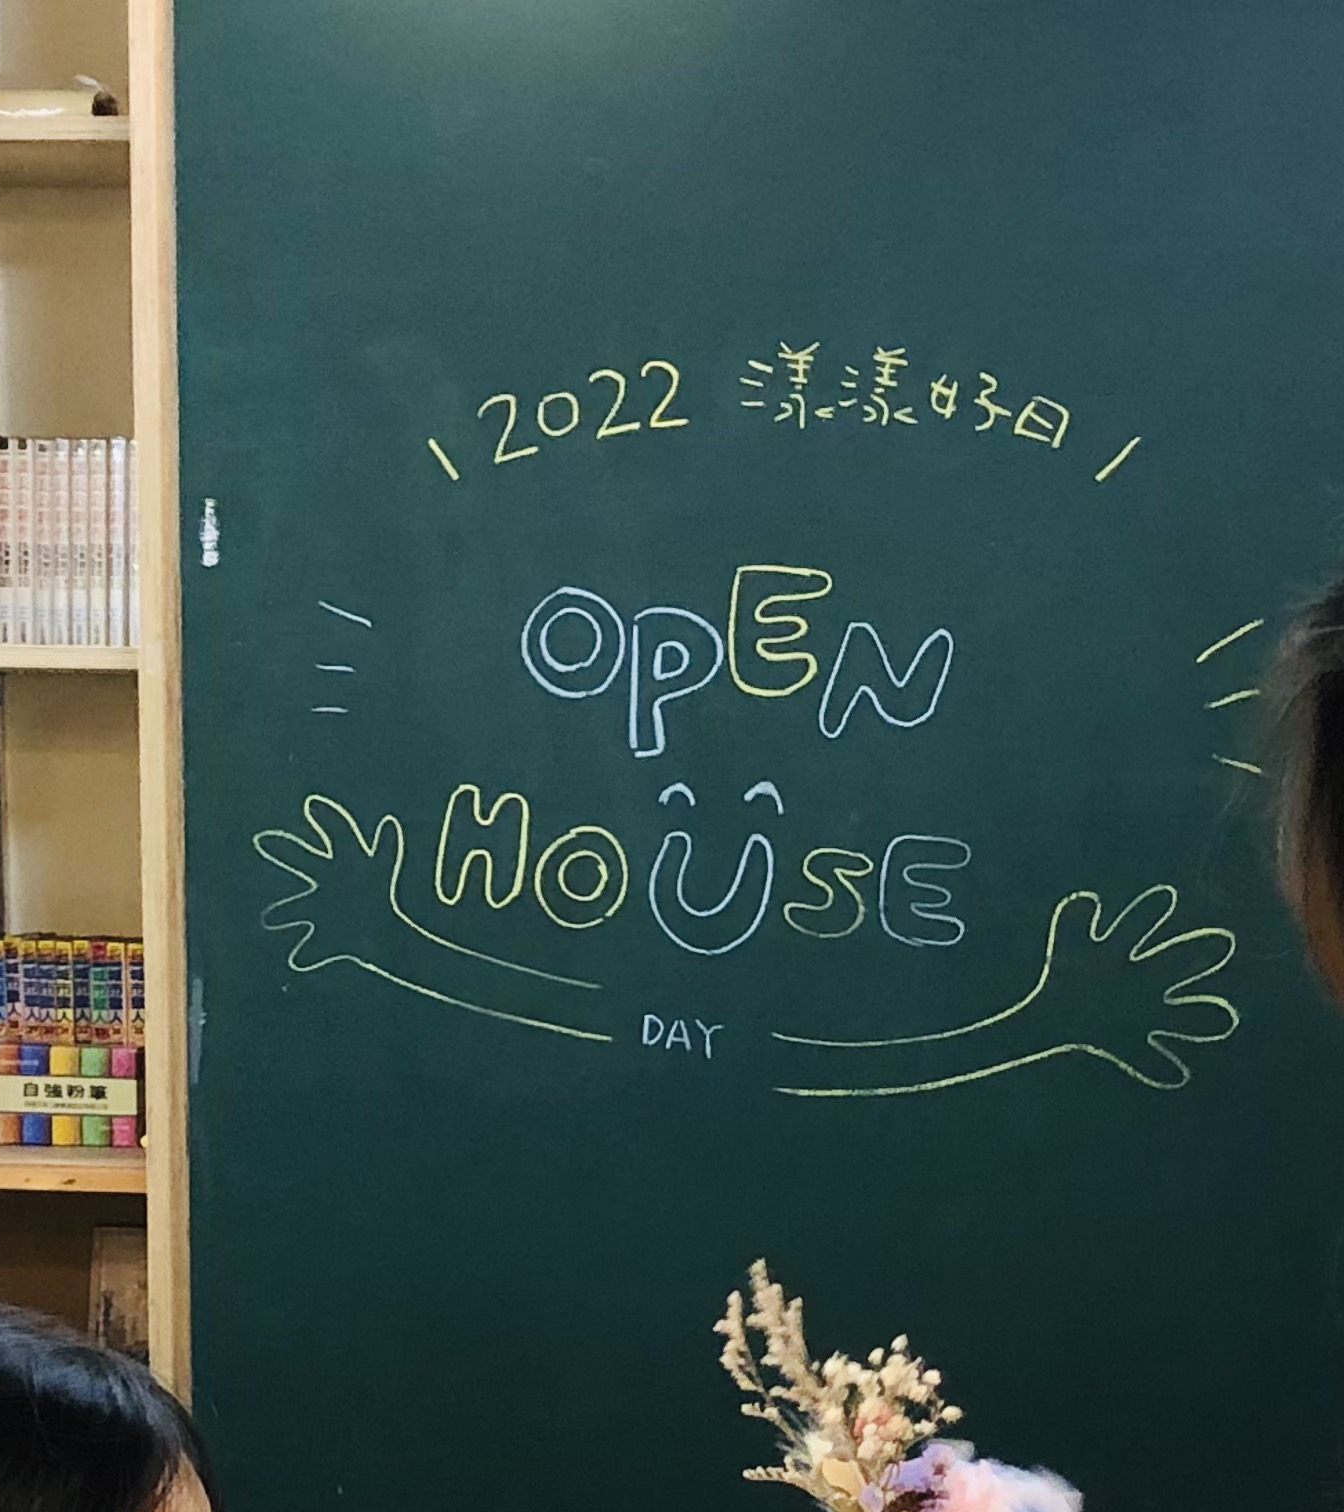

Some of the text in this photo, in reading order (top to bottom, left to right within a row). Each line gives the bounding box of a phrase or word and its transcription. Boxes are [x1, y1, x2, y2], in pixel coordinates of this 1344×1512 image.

[477, 341, 1070, 465] 2022 漾漾好日
[521, 565, 954, 758] OPEN
[642, 1014, 724, 1058] DAY
